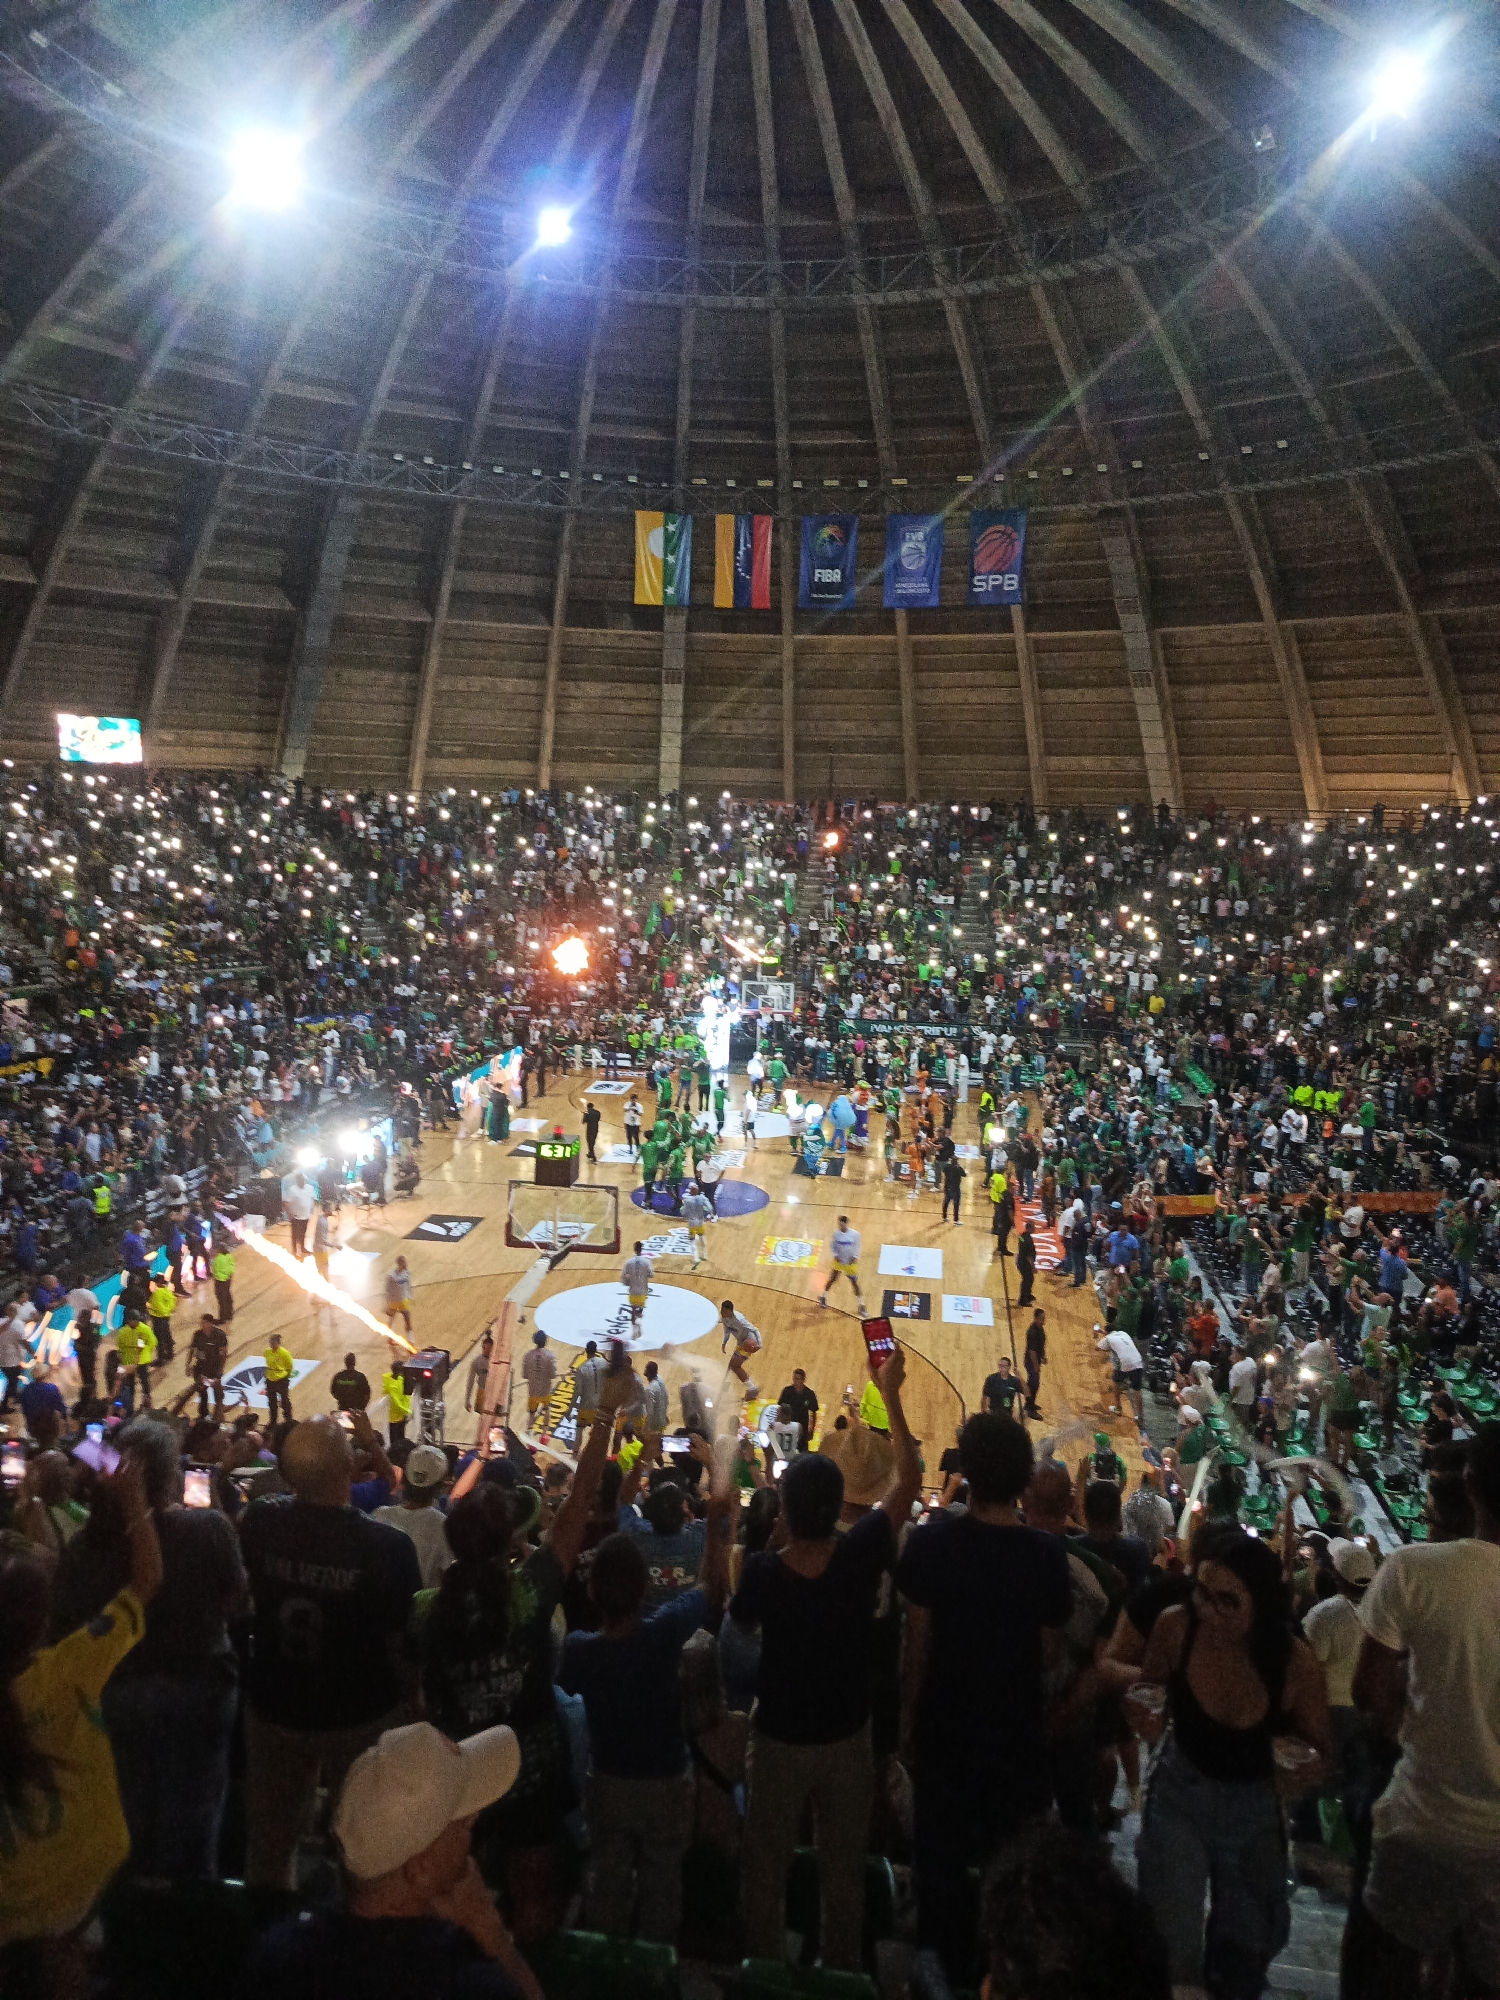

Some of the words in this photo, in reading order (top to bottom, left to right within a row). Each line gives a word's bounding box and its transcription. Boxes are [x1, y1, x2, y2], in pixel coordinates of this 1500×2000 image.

[814, 568, 842, 583] FIBA
[972, 573, 1020, 593] SPB
[778, 1432, 793, 1451] 13
